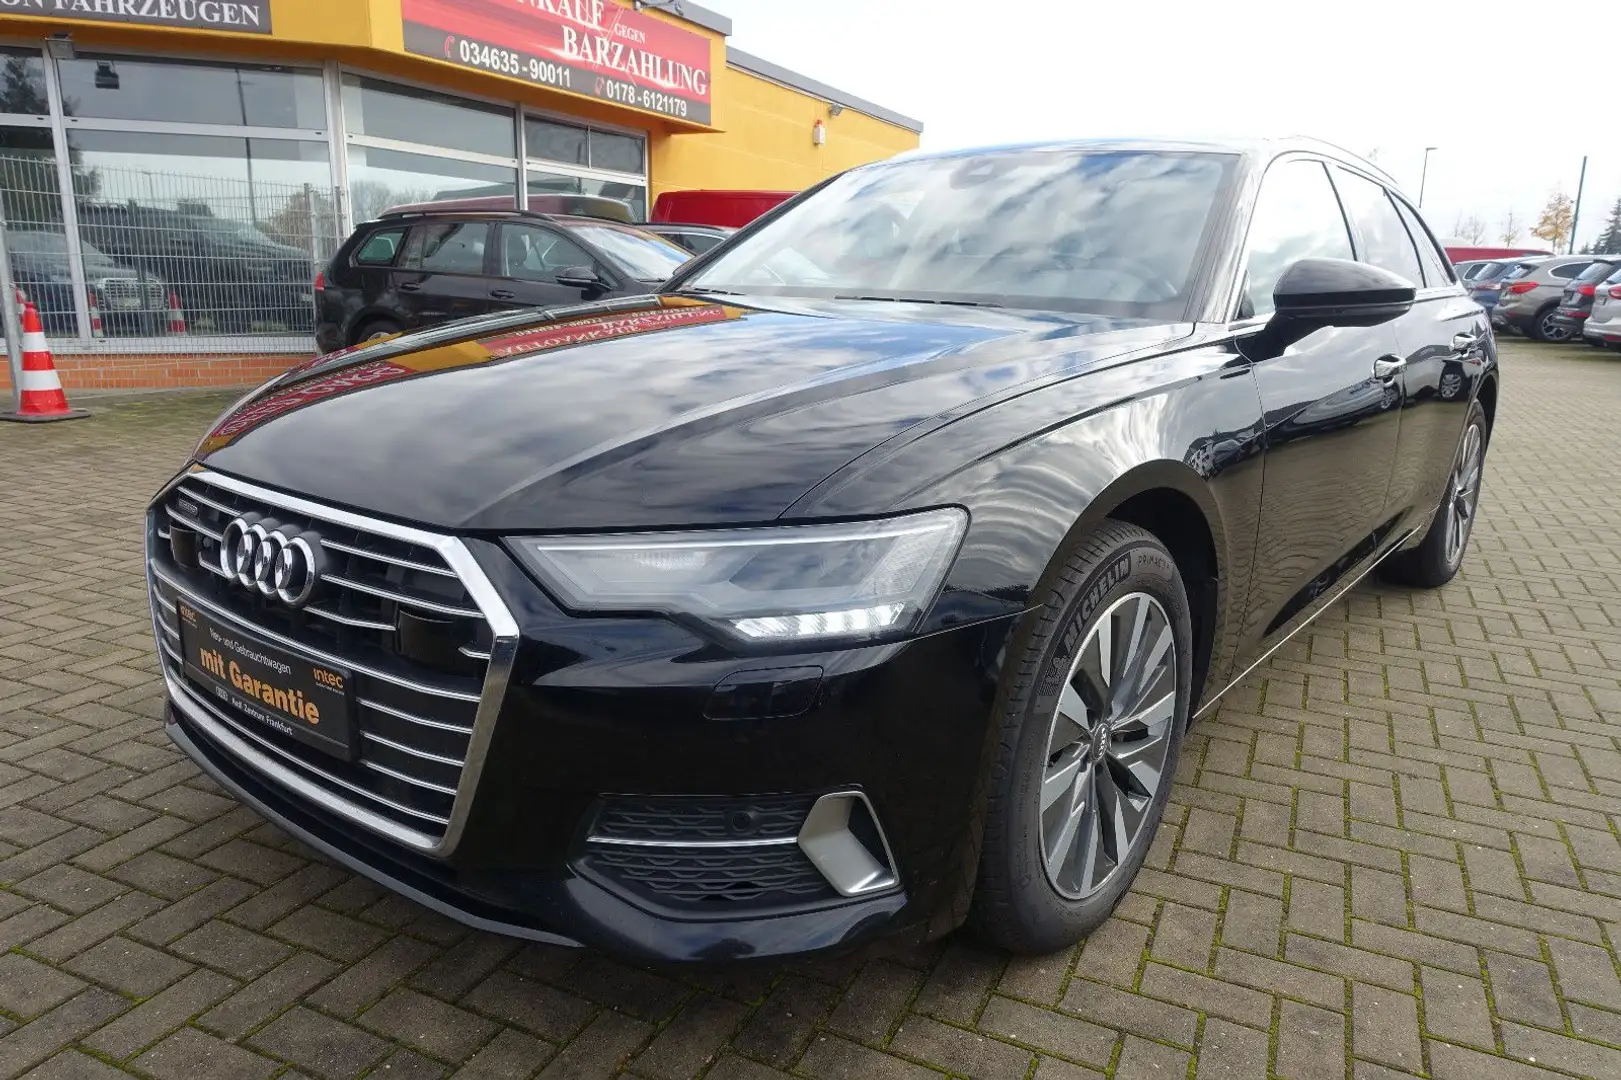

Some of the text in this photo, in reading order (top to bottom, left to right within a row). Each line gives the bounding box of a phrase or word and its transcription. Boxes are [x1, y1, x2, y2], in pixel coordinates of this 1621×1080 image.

[614, 23, 646, 44] GEGEN
[562, 25, 707, 95] BARZAHLUNG
[1063, 558, 1130, 655] MICHELIN
[234, 641, 292, 675] Gebrauchtwagen
[200, 648, 320, 725] mit Garantie
[265, 715, 294, 735] Frankfurt
